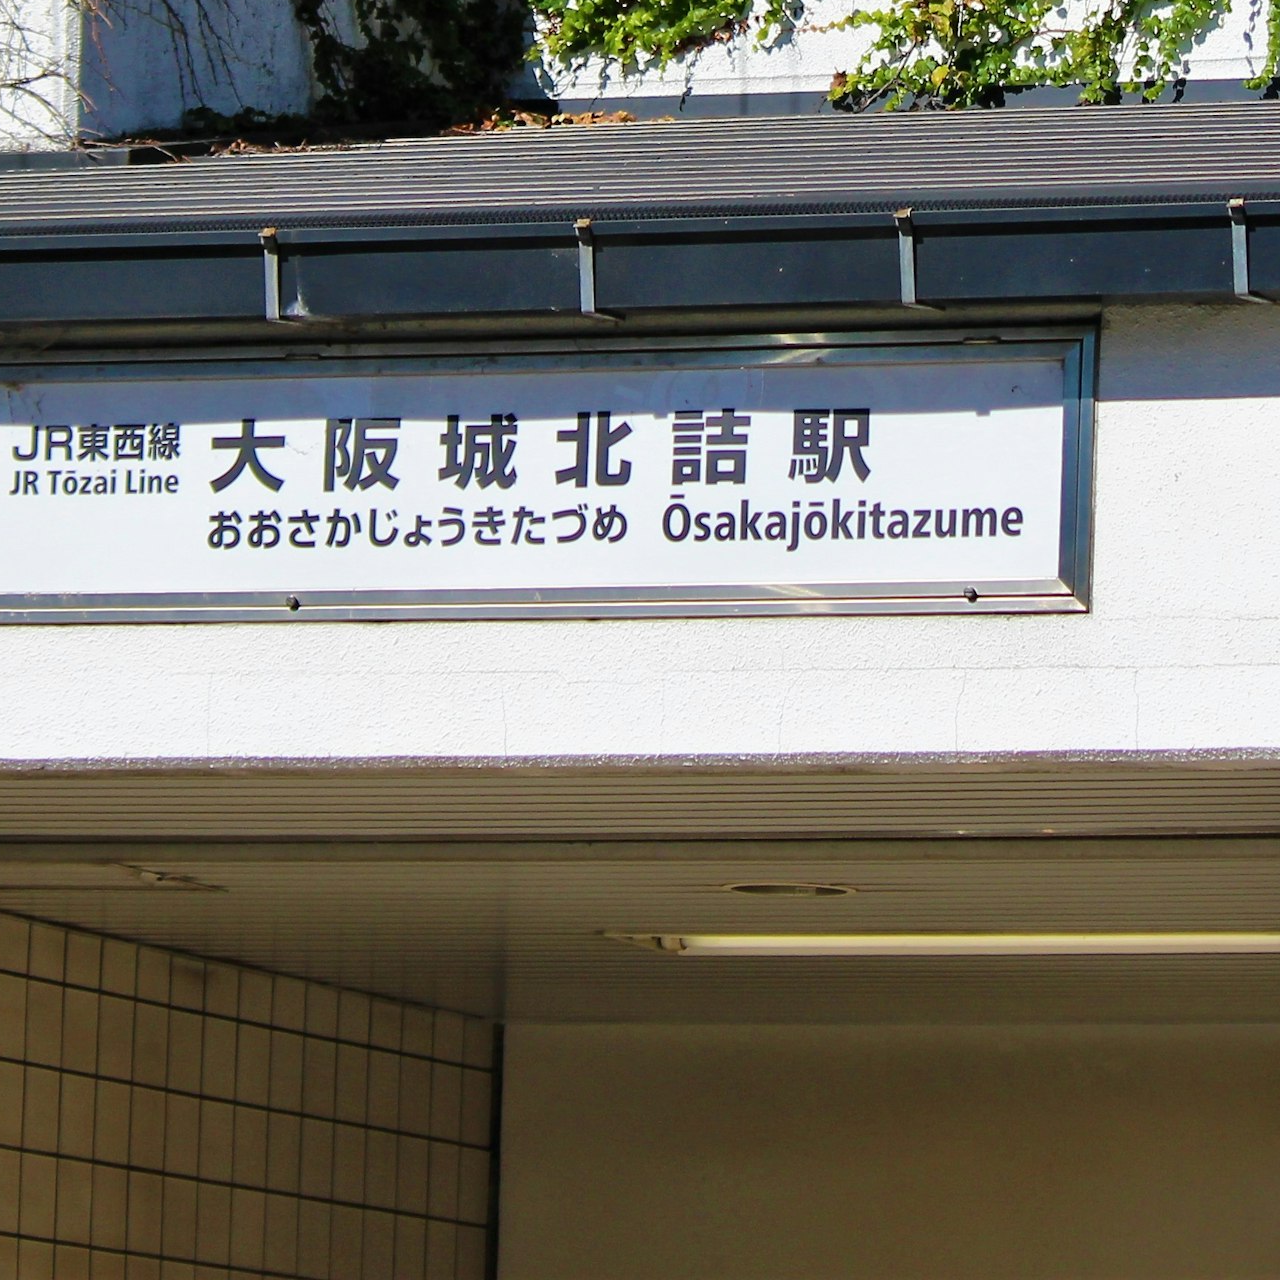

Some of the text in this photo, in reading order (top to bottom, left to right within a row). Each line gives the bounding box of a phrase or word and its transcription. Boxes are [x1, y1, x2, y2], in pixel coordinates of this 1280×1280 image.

[12, 424, 181, 461] JR東西線
[209, 409, 872, 493] 大阪城北詰駅
[10, 468, 179, 495] JR Tōzai Line
[208, 504, 628, 549] おおさかじょうきたづめ
[663, 494, 1023, 552] Ōsakajōkitazume
